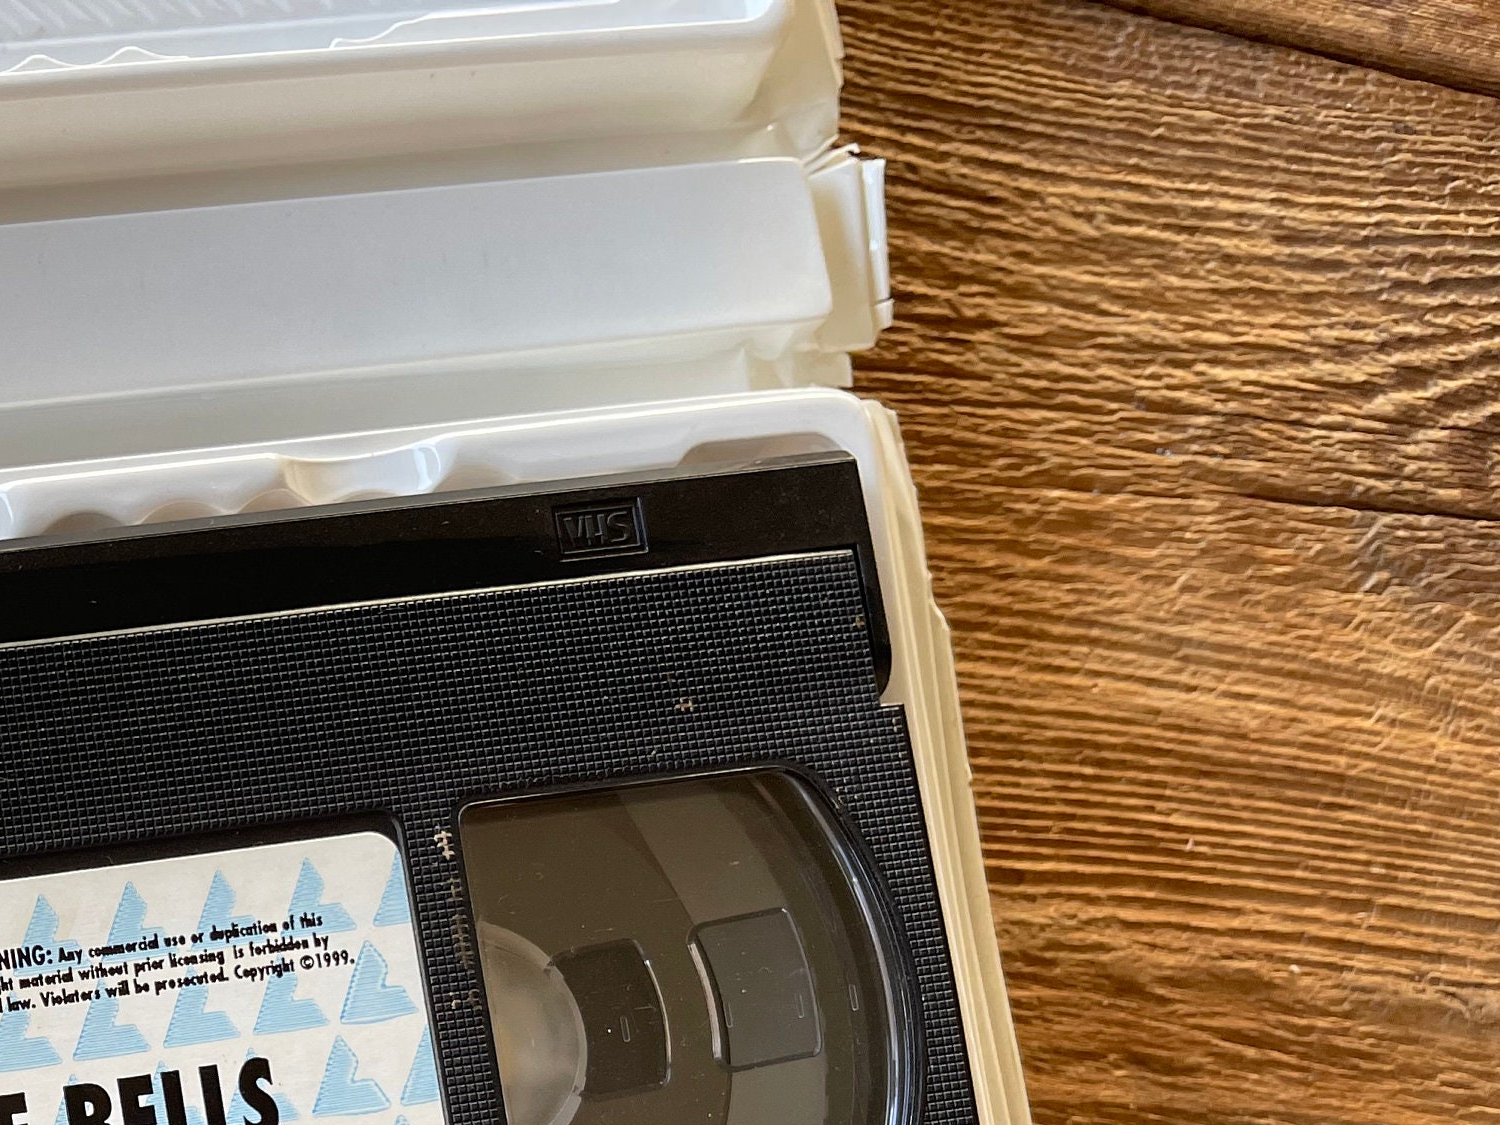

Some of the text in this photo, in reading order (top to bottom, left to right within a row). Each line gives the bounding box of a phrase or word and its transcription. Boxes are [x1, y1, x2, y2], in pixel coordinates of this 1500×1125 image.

[563, 511, 630, 548] VHS
[19, 966, 74, 989] material
[78, 961, 129, 981] without
[134, 956, 165, 977] prior
[168, 949, 225, 969] licensing
[233, 944, 244, 960] is
[249, 935, 309, 957] forbidden
[312, 932, 329, 950] by
[58, 947, 83, 965] Any
[88, 933, 159, 958] commercial
[164, 933, 186, 948] use
[190, 931, 204, 945] or
[209, 920, 277, 943] duplication
[282, 914, 295, 931] of
[299, 912, 323, 930] this
[7, 996, 36, 1012] law.
[105, 979, 130, 998] will
[133, 978, 149, 994] be
[154, 966, 229, 995] prosecuted.
[234, 957, 295, 983] Copyright
